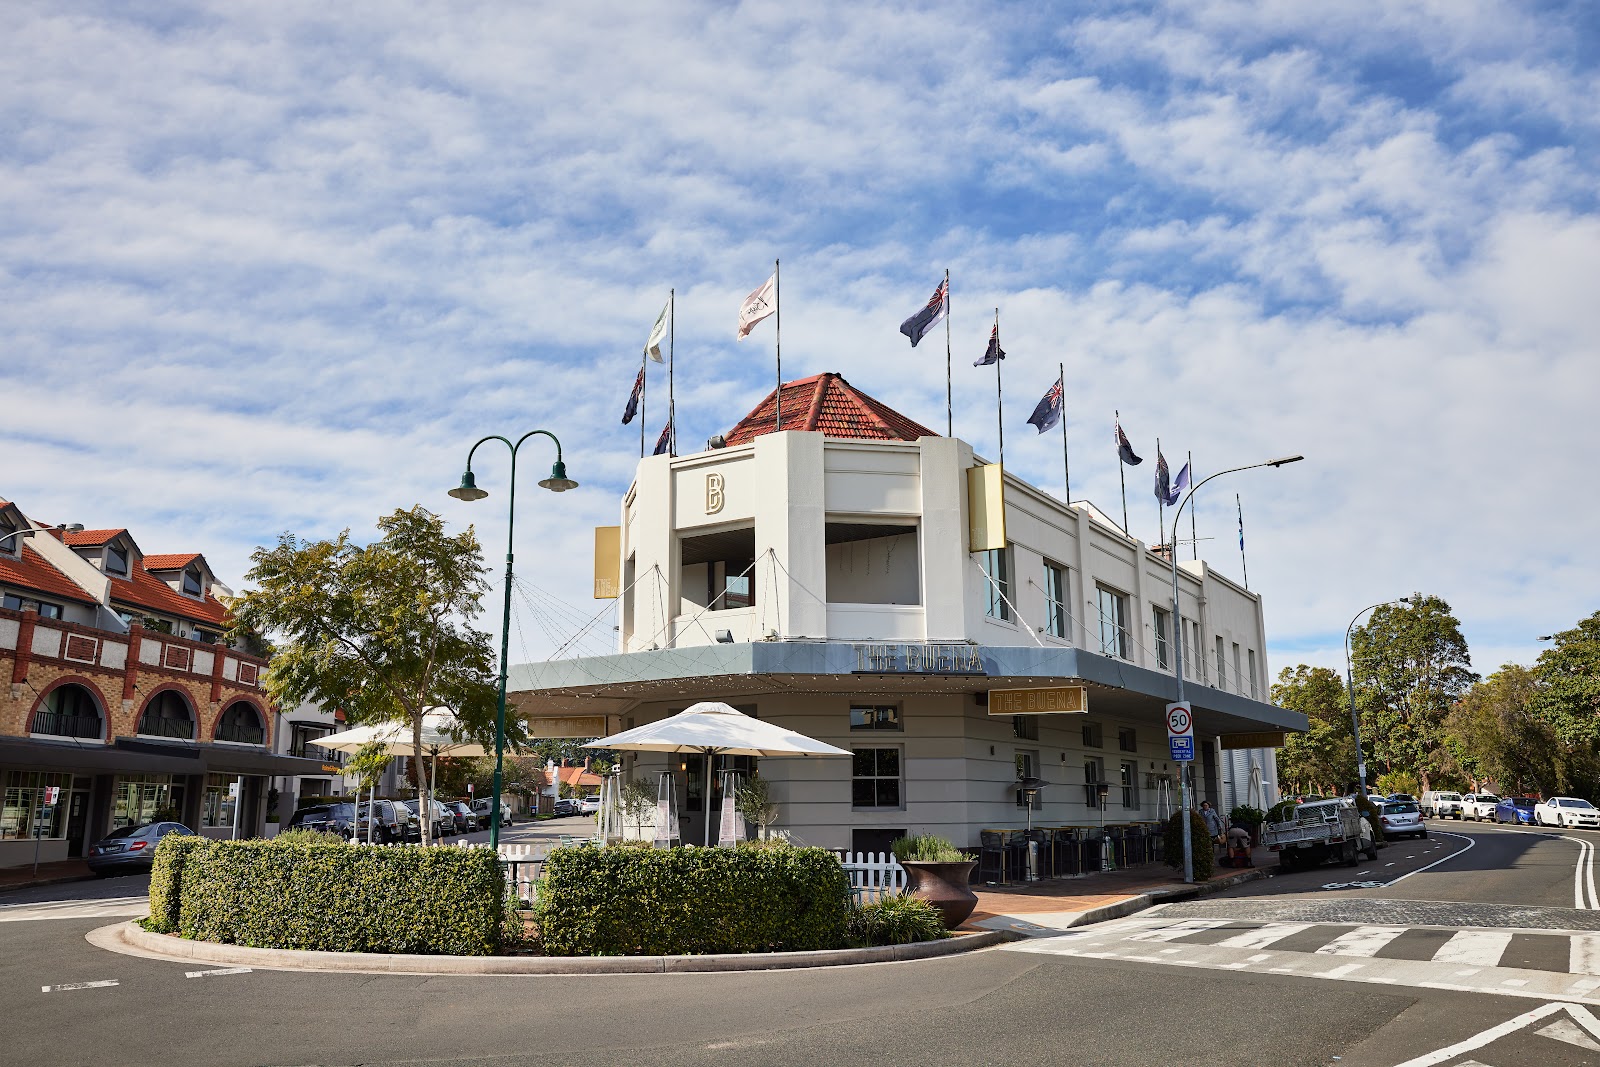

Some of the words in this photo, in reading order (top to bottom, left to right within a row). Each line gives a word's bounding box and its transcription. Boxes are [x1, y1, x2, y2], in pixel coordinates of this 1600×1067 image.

[704, 472, 725, 515] B
[853, 644, 898, 671] THE
[906, 645, 983, 671] BUENA
[995, 693, 1022, 711] THE
[1027, 691, 1077, 710] BUENA
[1171, 714, 1187, 727] 50
